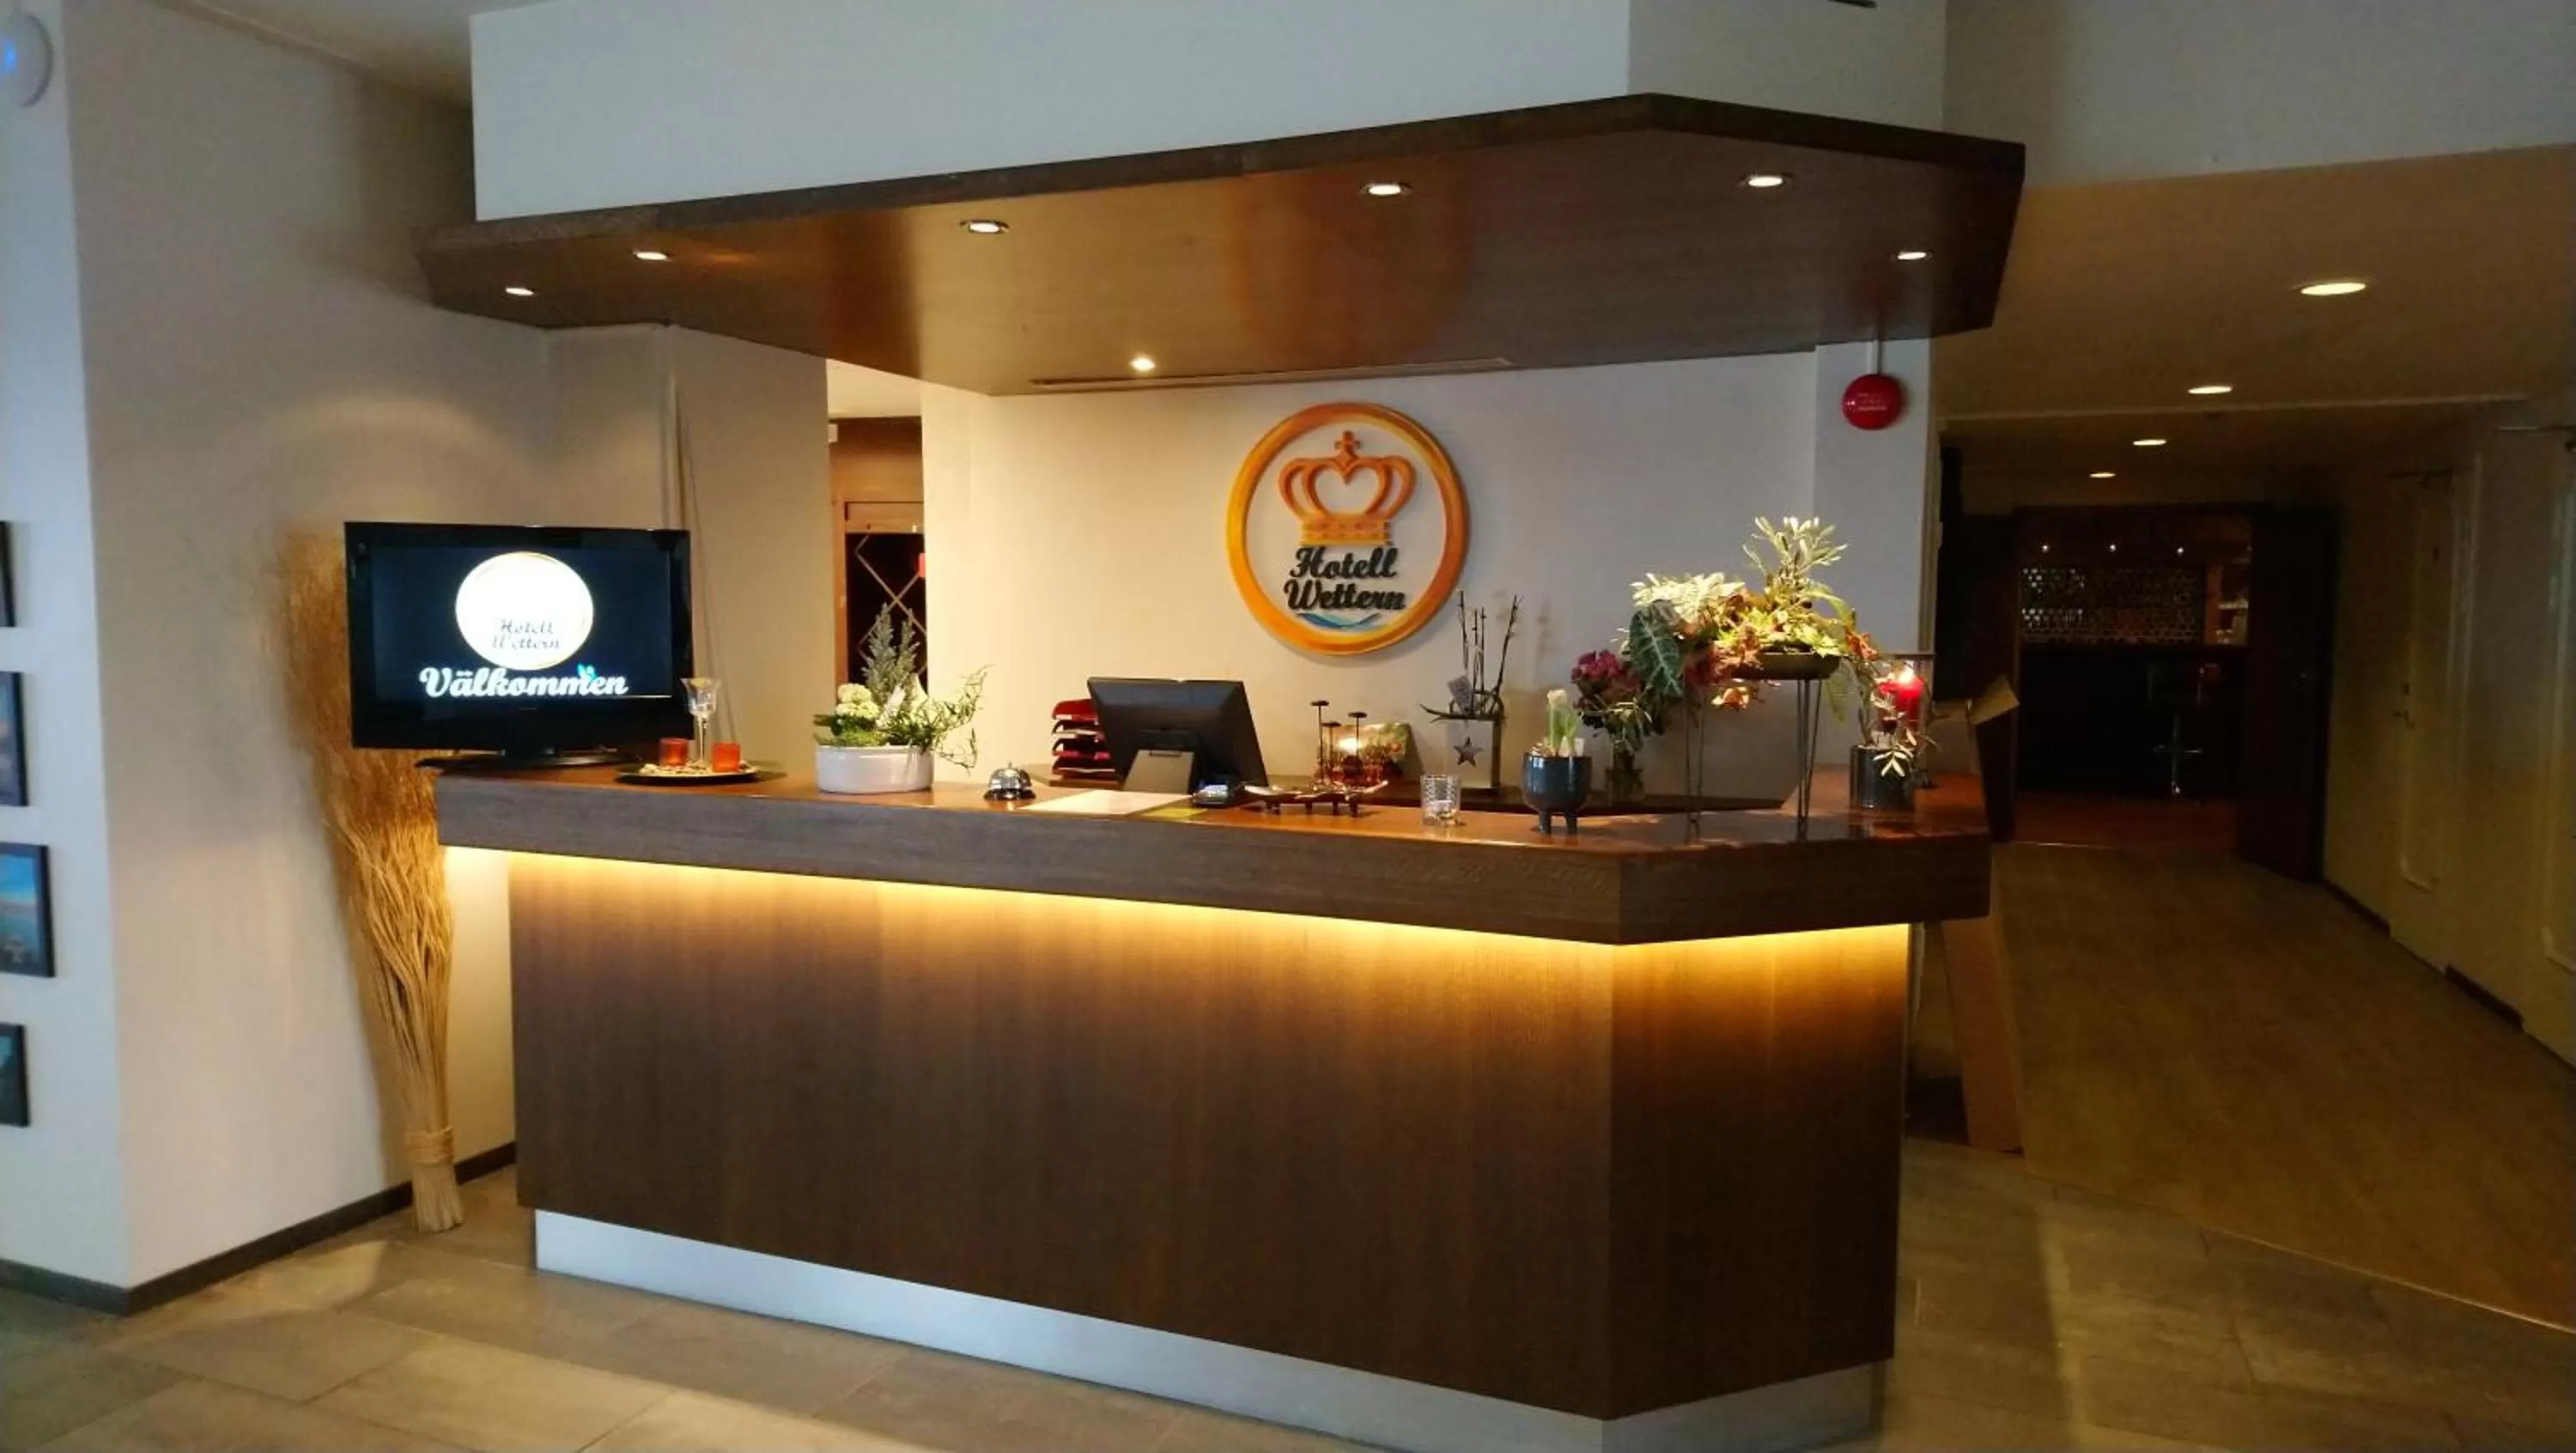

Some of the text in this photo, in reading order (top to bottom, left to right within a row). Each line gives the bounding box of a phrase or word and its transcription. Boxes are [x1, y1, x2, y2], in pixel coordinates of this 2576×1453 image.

[1290, 547, 1398, 578] Hotell
[1284, 579, 1406, 611] Wettern
[500, 619, 554, 635] Hotell
[419, 666, 629, 698] Välkommen
